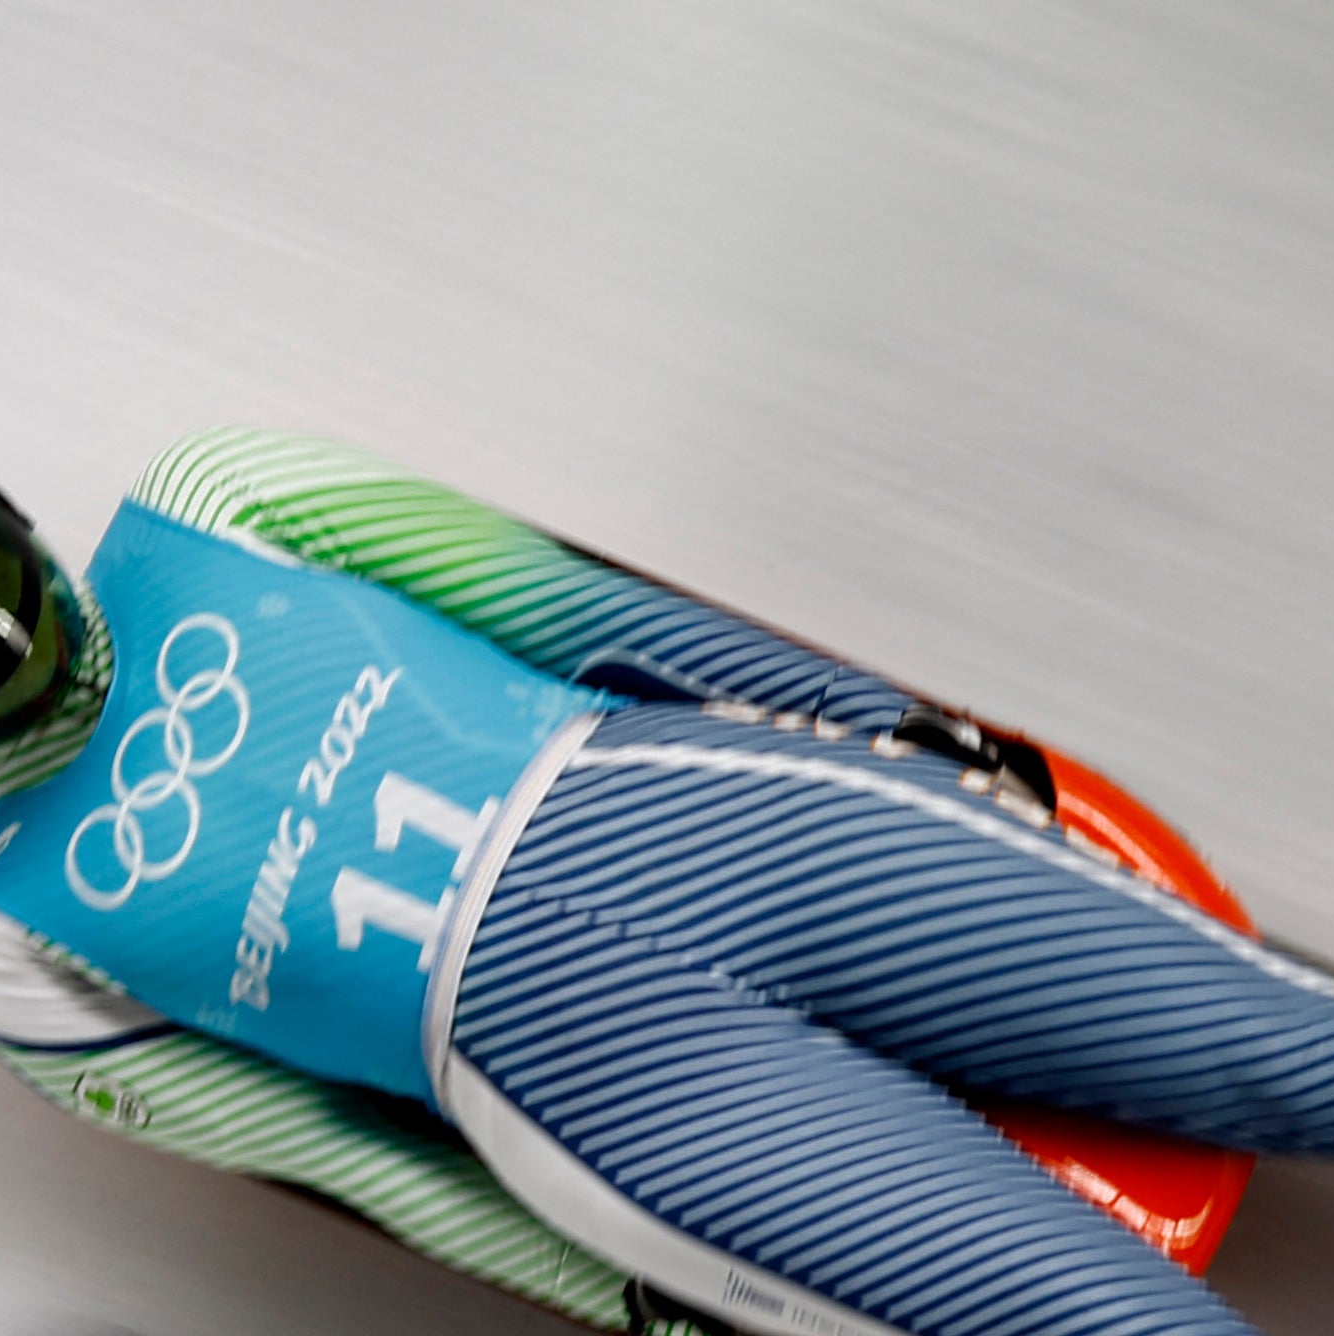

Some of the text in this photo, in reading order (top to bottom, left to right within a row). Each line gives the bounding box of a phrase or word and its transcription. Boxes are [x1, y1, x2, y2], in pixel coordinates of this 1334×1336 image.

[229, 664, 405, 1010] BEIJING 2022
[331, 770, 499, 972] 11
